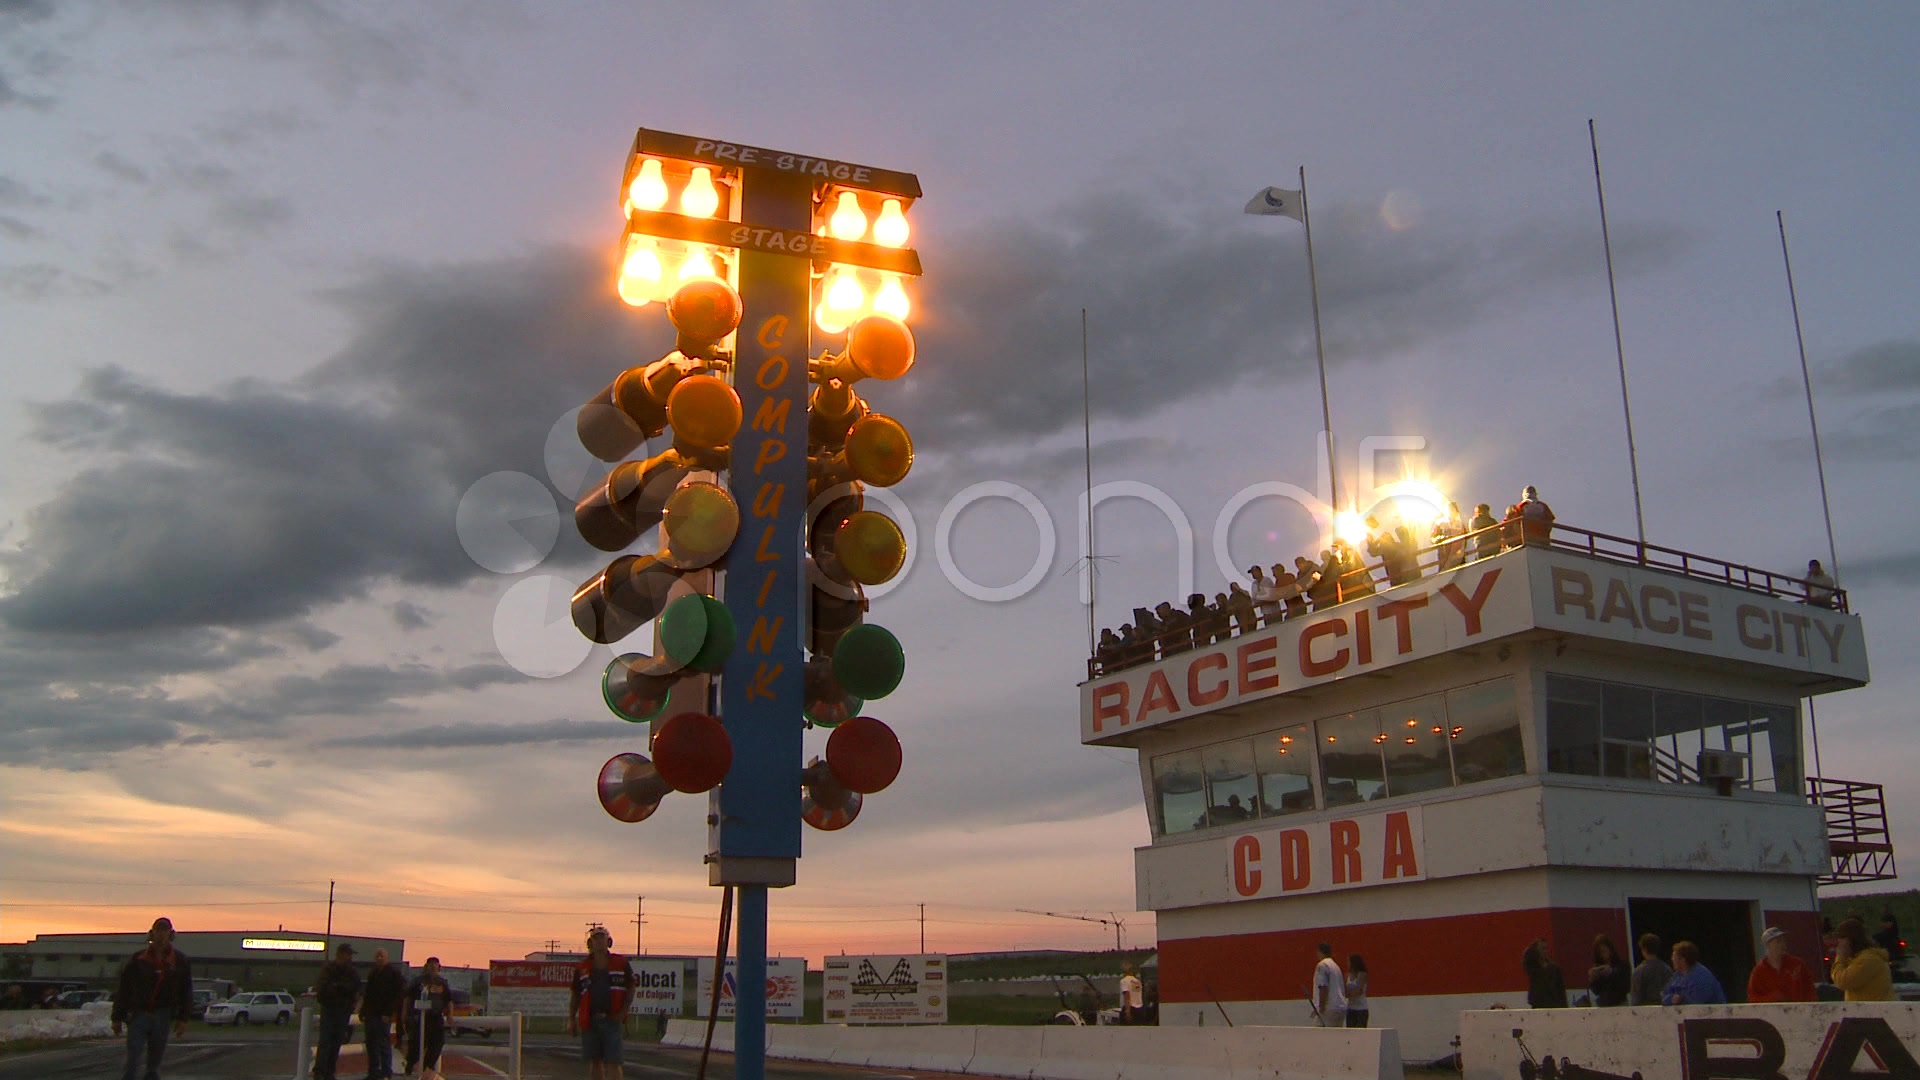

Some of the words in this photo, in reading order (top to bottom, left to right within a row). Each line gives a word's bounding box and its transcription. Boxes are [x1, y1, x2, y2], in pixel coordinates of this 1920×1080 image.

[694, 140, 871, 183] PRE-STAGE
[730, 227, 828, 254] STAGE
[746, 313, 792, 701] COMPULINK
[1550, 565, 1713, 641] RACE
[1736, 603, 1846, 663] CITY
[1092, 636, 1280, 733] RACE
[1300, 567, 1503, 678] CITY
[1233, 811, 1418, 897] CDRA
[634, 970, 676, 988] obcat
[636, 990, 644, 999] of
[645, 990, 676, 1001] Calgary
